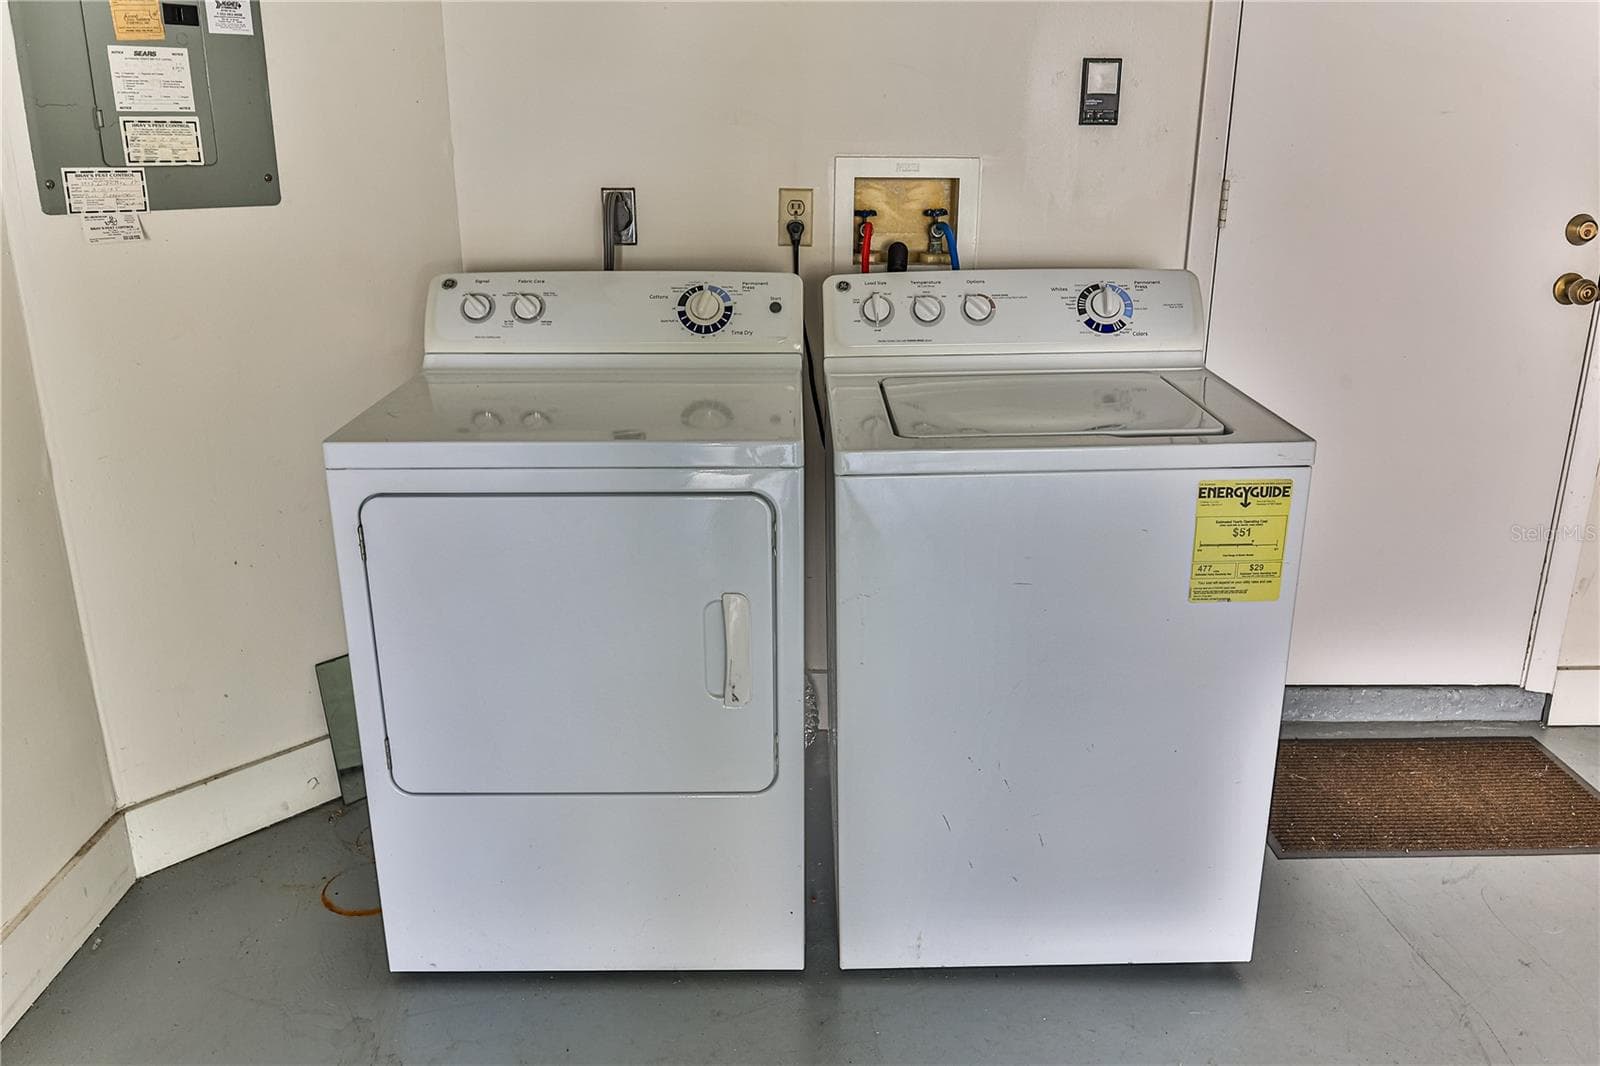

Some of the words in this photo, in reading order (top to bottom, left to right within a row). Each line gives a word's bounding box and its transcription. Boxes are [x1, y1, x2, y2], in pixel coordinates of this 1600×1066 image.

[1198, 486, 1292, 500] ENERGYGUIDE
[1232, 527, 1251, 538] $51
[1249, 564, 1264, 572] $29
